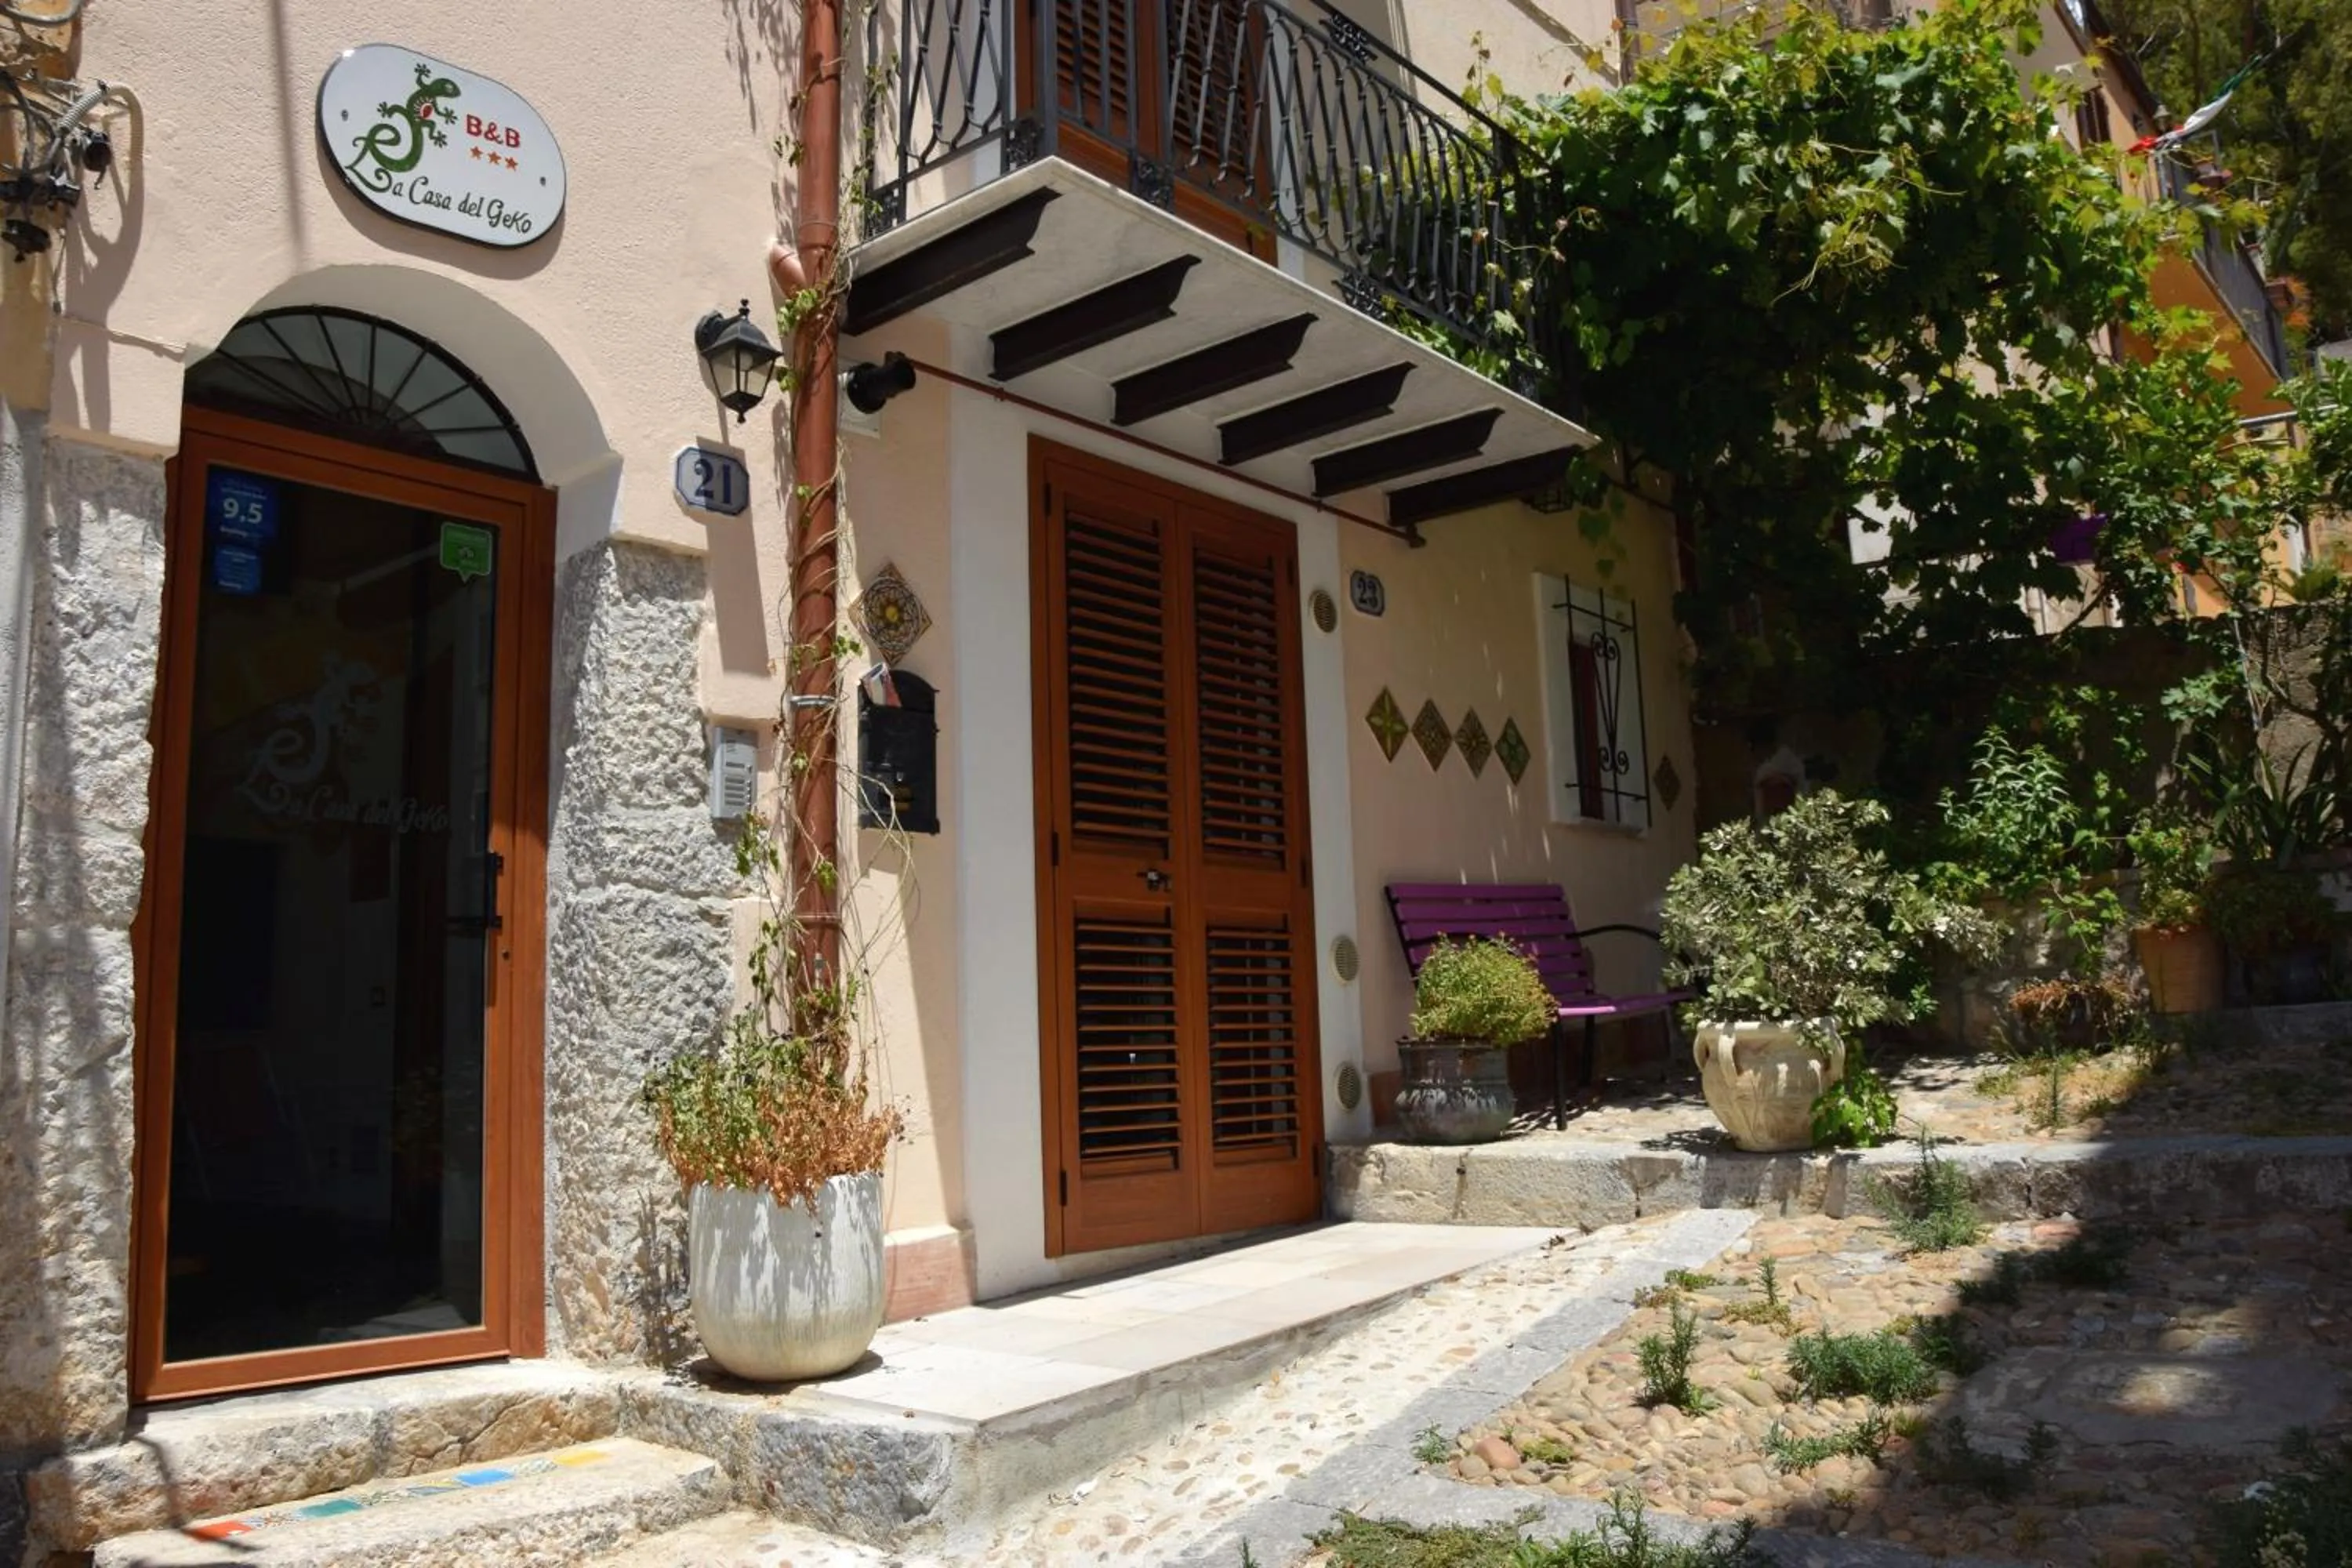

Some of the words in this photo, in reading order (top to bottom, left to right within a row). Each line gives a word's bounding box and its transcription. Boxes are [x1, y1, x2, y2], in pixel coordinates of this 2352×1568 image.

[466, 114, 521, 148] B&B
[408, 176, 451, 210] Casa
[458, 193, 485, 217] del
[694, 458, 731, 504] 21
[1357, 576, 1378, 609] 23
